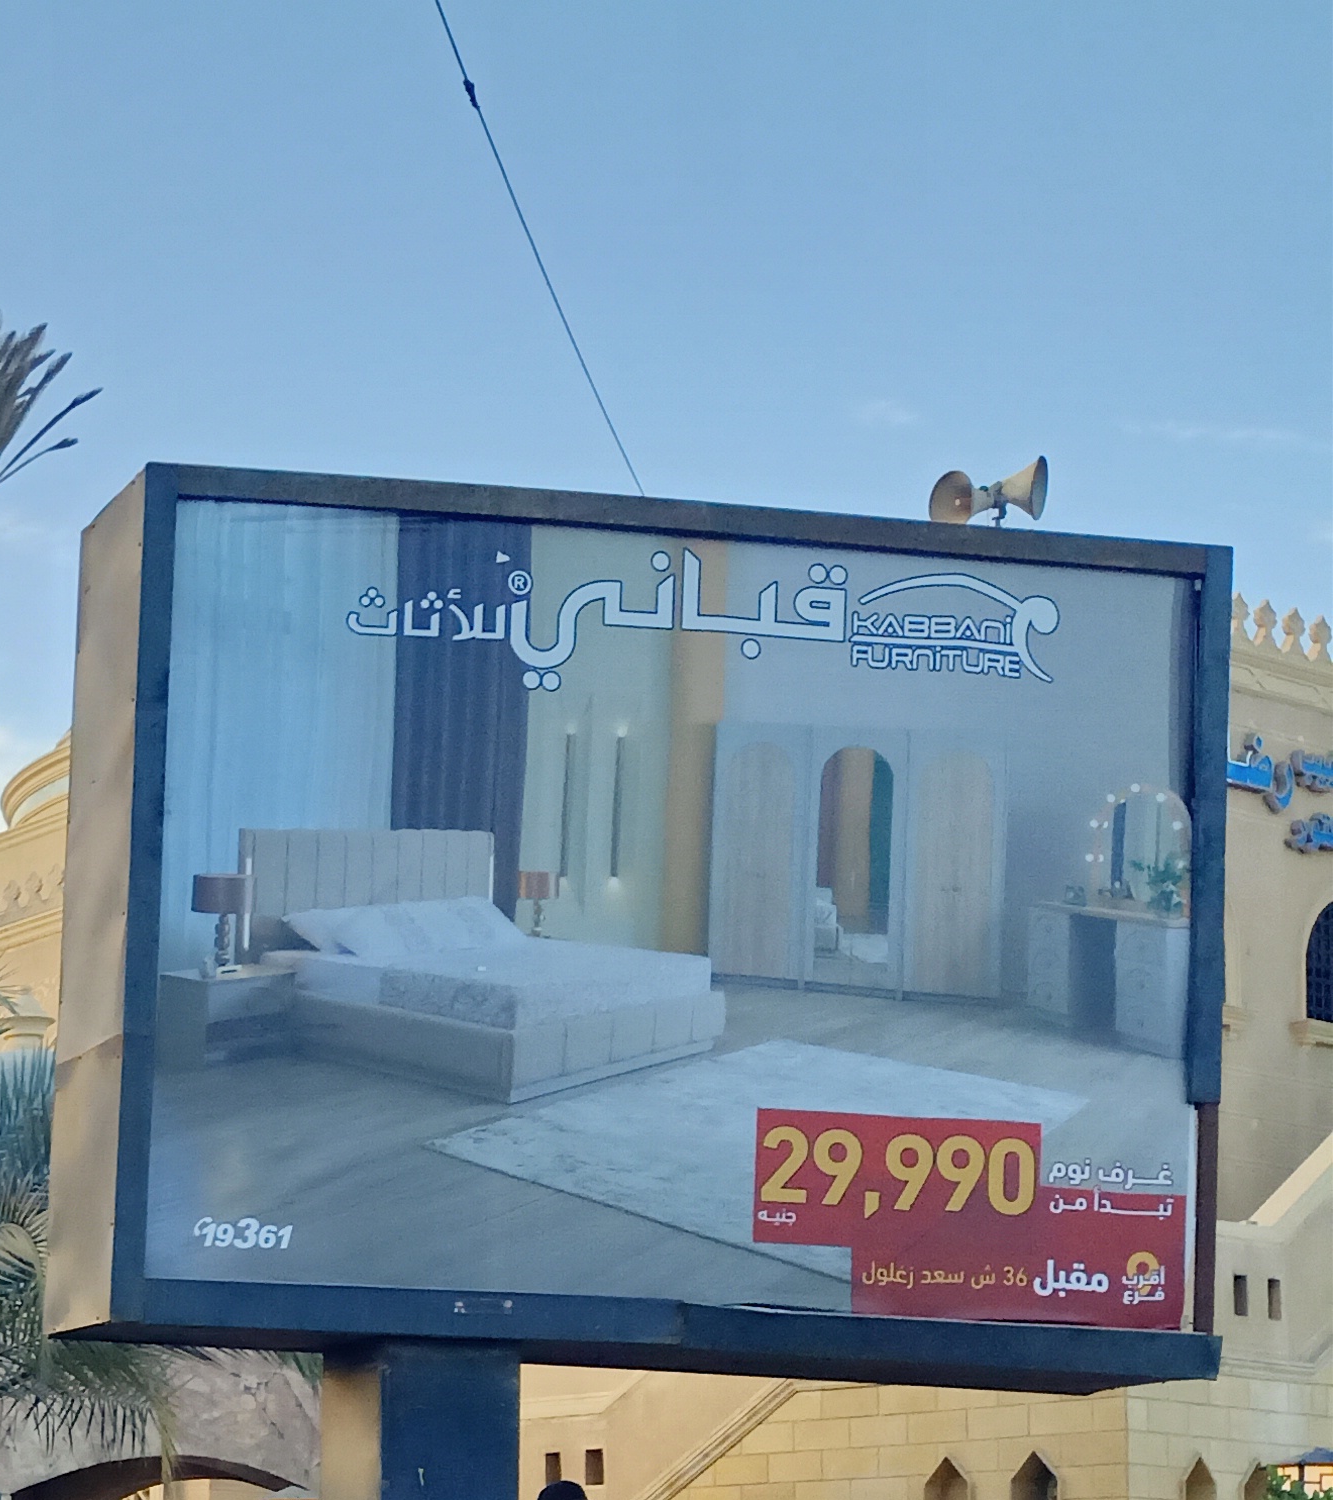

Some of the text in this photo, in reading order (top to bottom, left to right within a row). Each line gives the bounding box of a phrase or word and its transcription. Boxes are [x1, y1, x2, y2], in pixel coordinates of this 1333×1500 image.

[346, 548, 846, 692] قباني للأثاث
[760, 1125, 1035, 1219] 29,990
[1048, 1158, 1091, 1185] نوم
[1049, 1194, 1088, 1214] من
[201, 1217, 294, 1249] 19361
[862, 1259, 1110, 1297] مقبل 36 ش سعد زغلول
